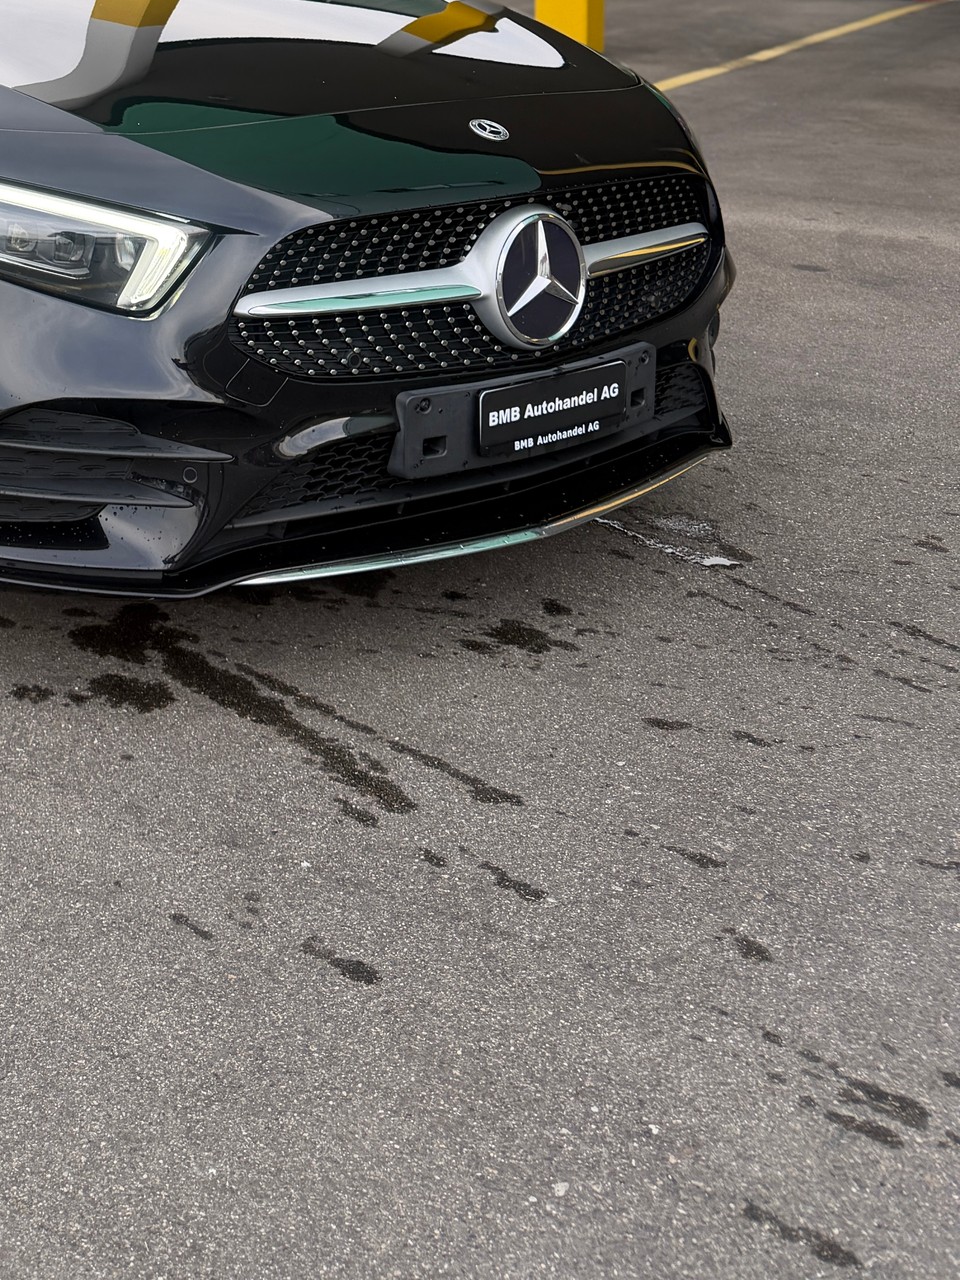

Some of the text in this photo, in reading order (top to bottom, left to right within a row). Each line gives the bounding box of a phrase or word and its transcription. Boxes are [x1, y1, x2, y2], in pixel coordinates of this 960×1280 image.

[488, 382, 619, 427] BMB Autohandel AG
[514, 420, 600, 451] BMB Autohandel AG
